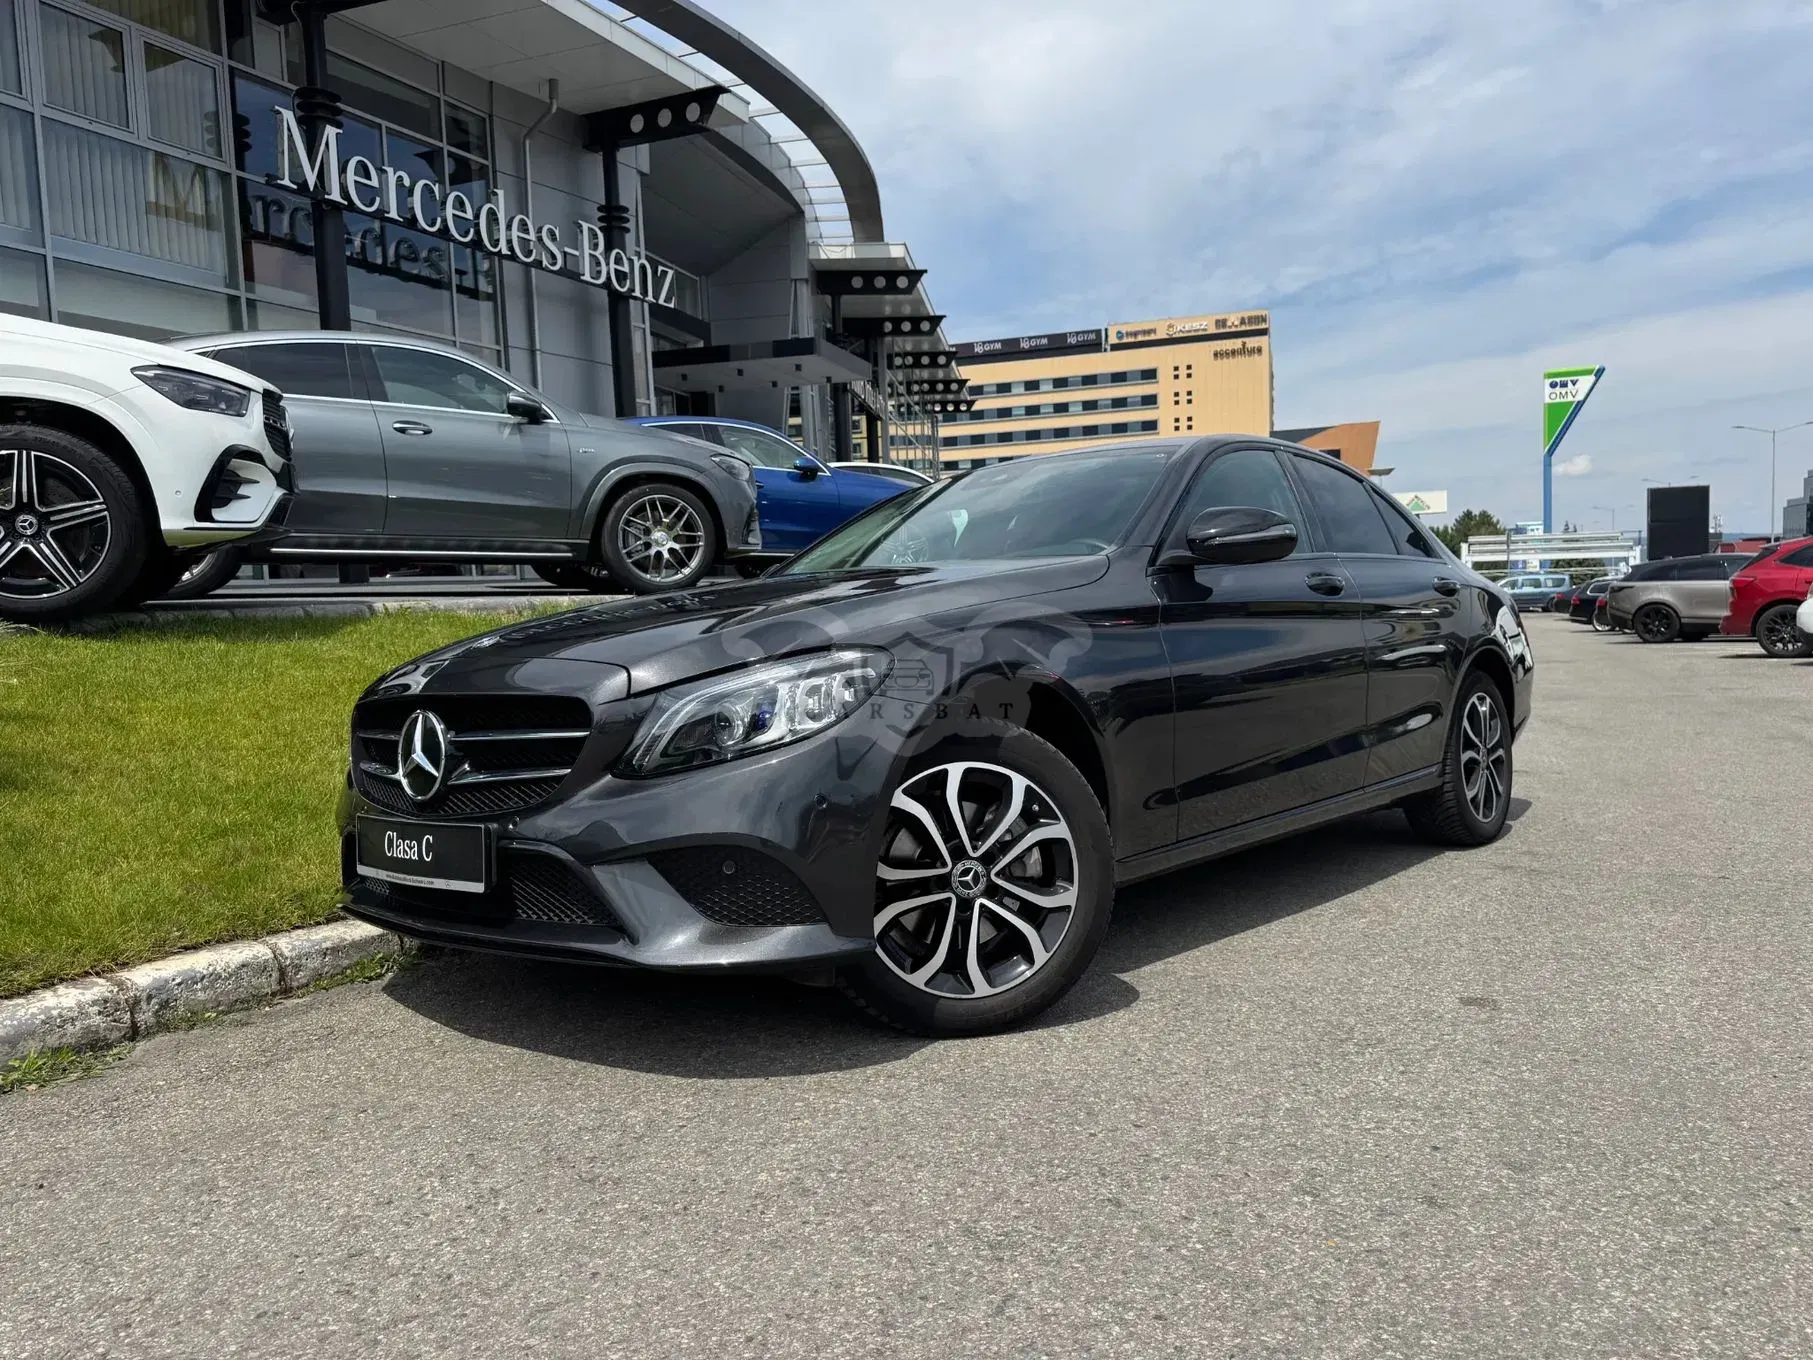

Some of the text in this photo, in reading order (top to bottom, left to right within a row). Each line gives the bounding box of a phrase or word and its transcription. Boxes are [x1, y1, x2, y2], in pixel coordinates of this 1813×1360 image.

[273, 105, 676, 309] Mercedes-Benz
[1549, 390, 1578, 400] OMV
[384, 830, 433, 862] Clasa C
